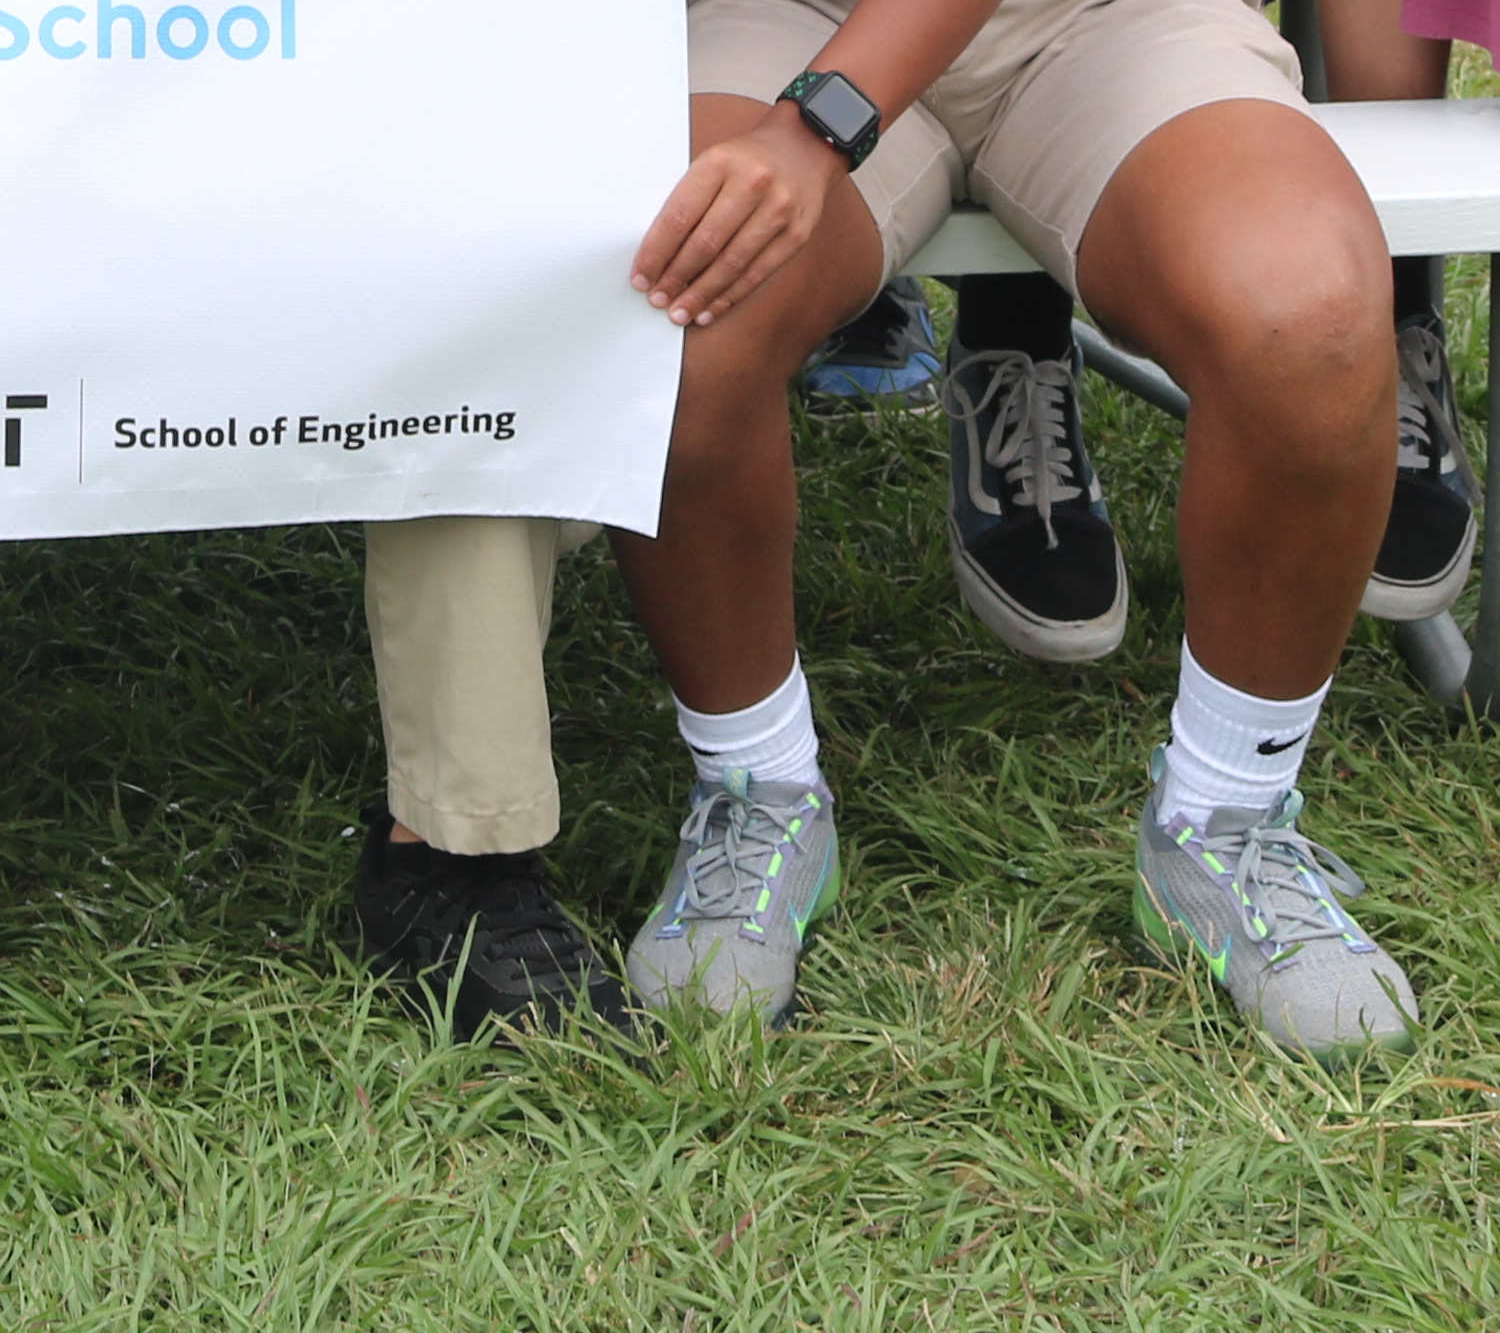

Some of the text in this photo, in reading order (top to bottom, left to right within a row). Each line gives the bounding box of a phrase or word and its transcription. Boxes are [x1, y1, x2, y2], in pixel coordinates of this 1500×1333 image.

[114, 405, 517, 450] School of Engineering
